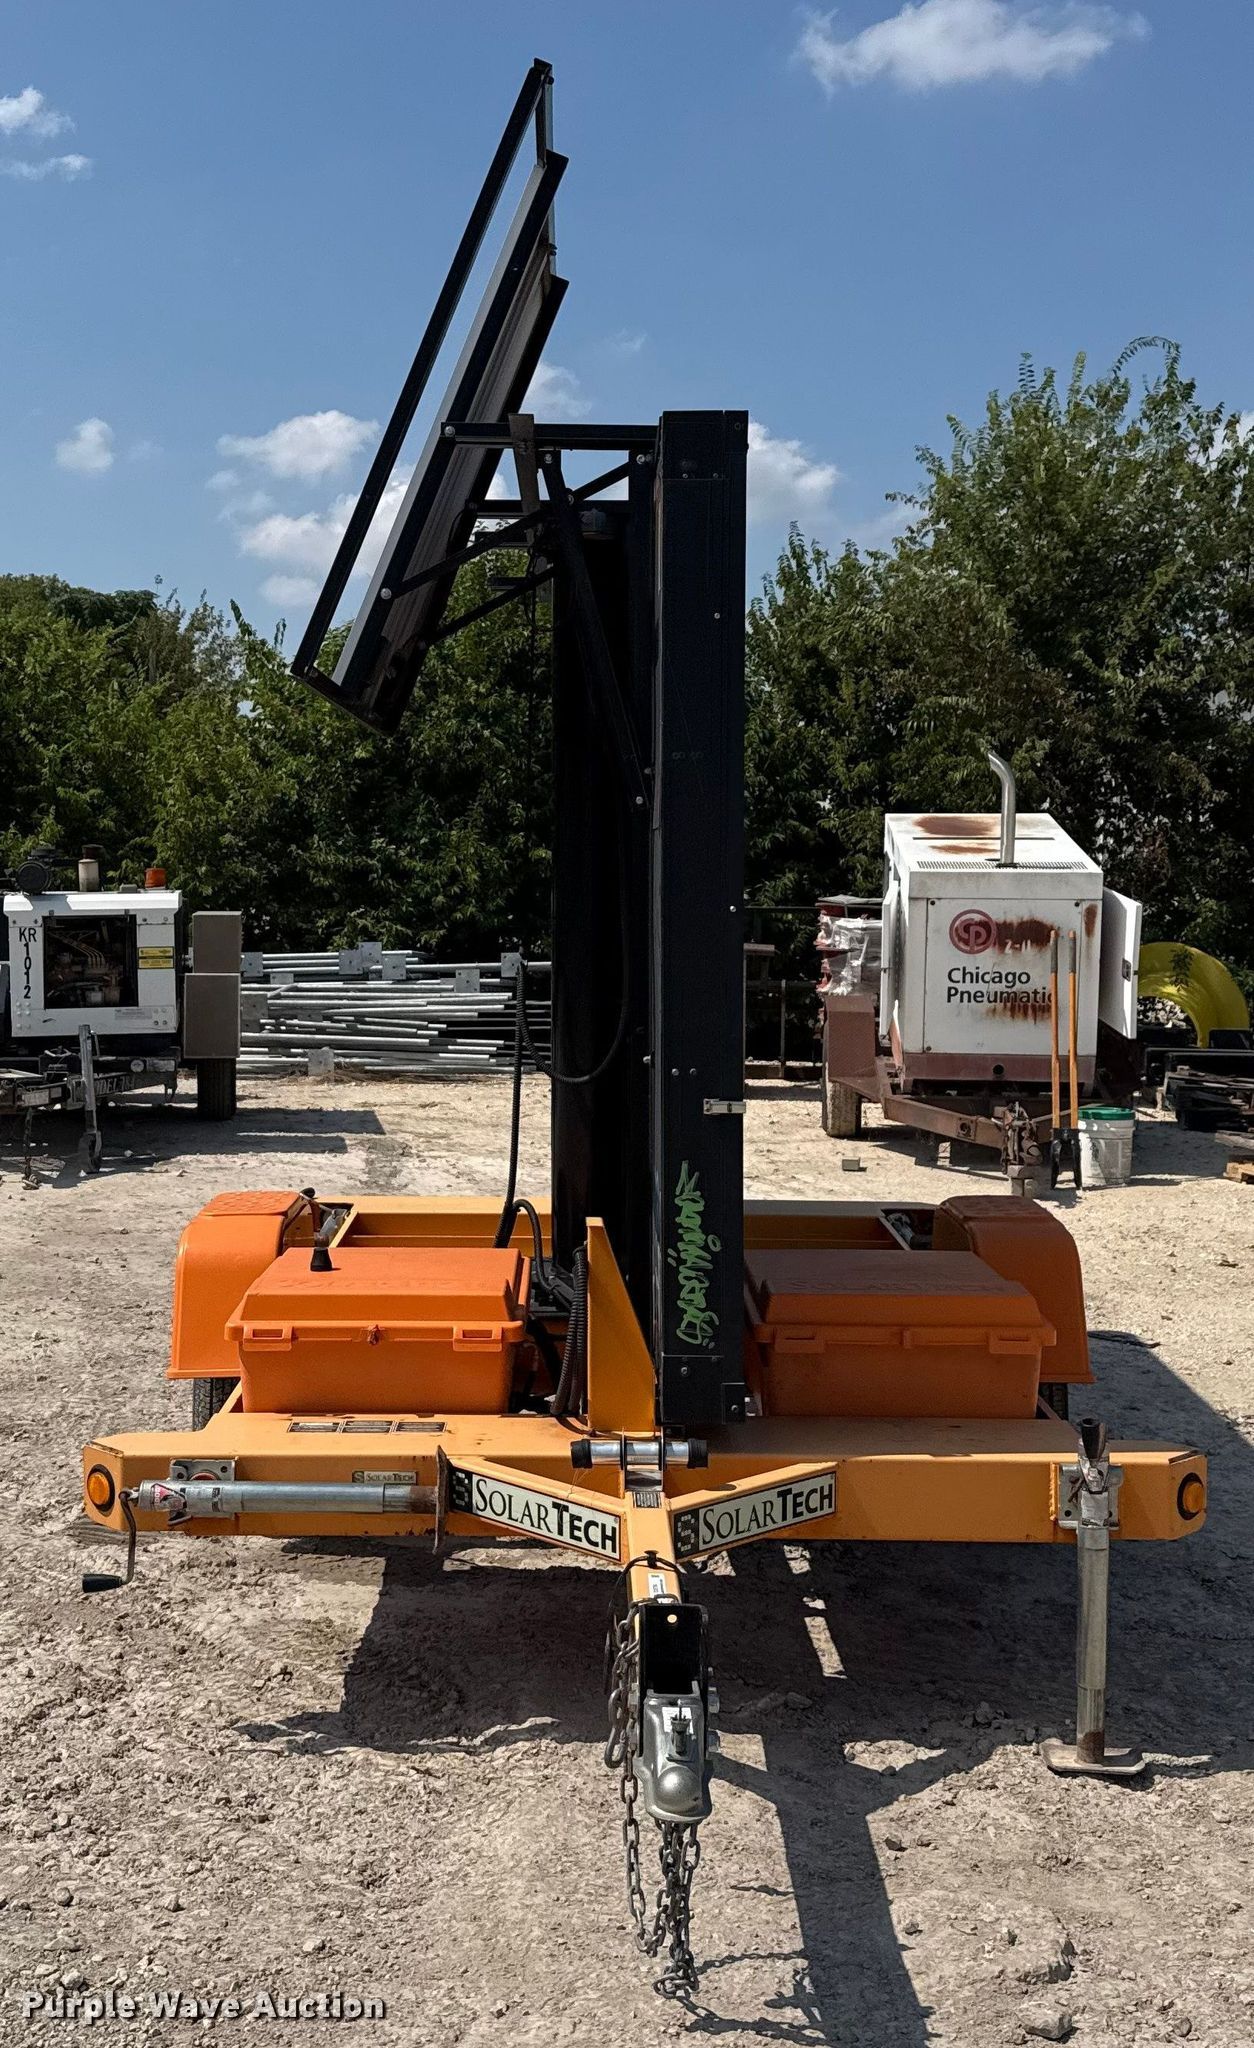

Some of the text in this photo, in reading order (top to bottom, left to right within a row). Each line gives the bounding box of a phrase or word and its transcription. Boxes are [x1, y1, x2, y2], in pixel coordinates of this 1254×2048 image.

[18, 927, 37, 942] KR
[23, 942, 32, 999] 1012
[947, 966, 1031, 988] Chicago
